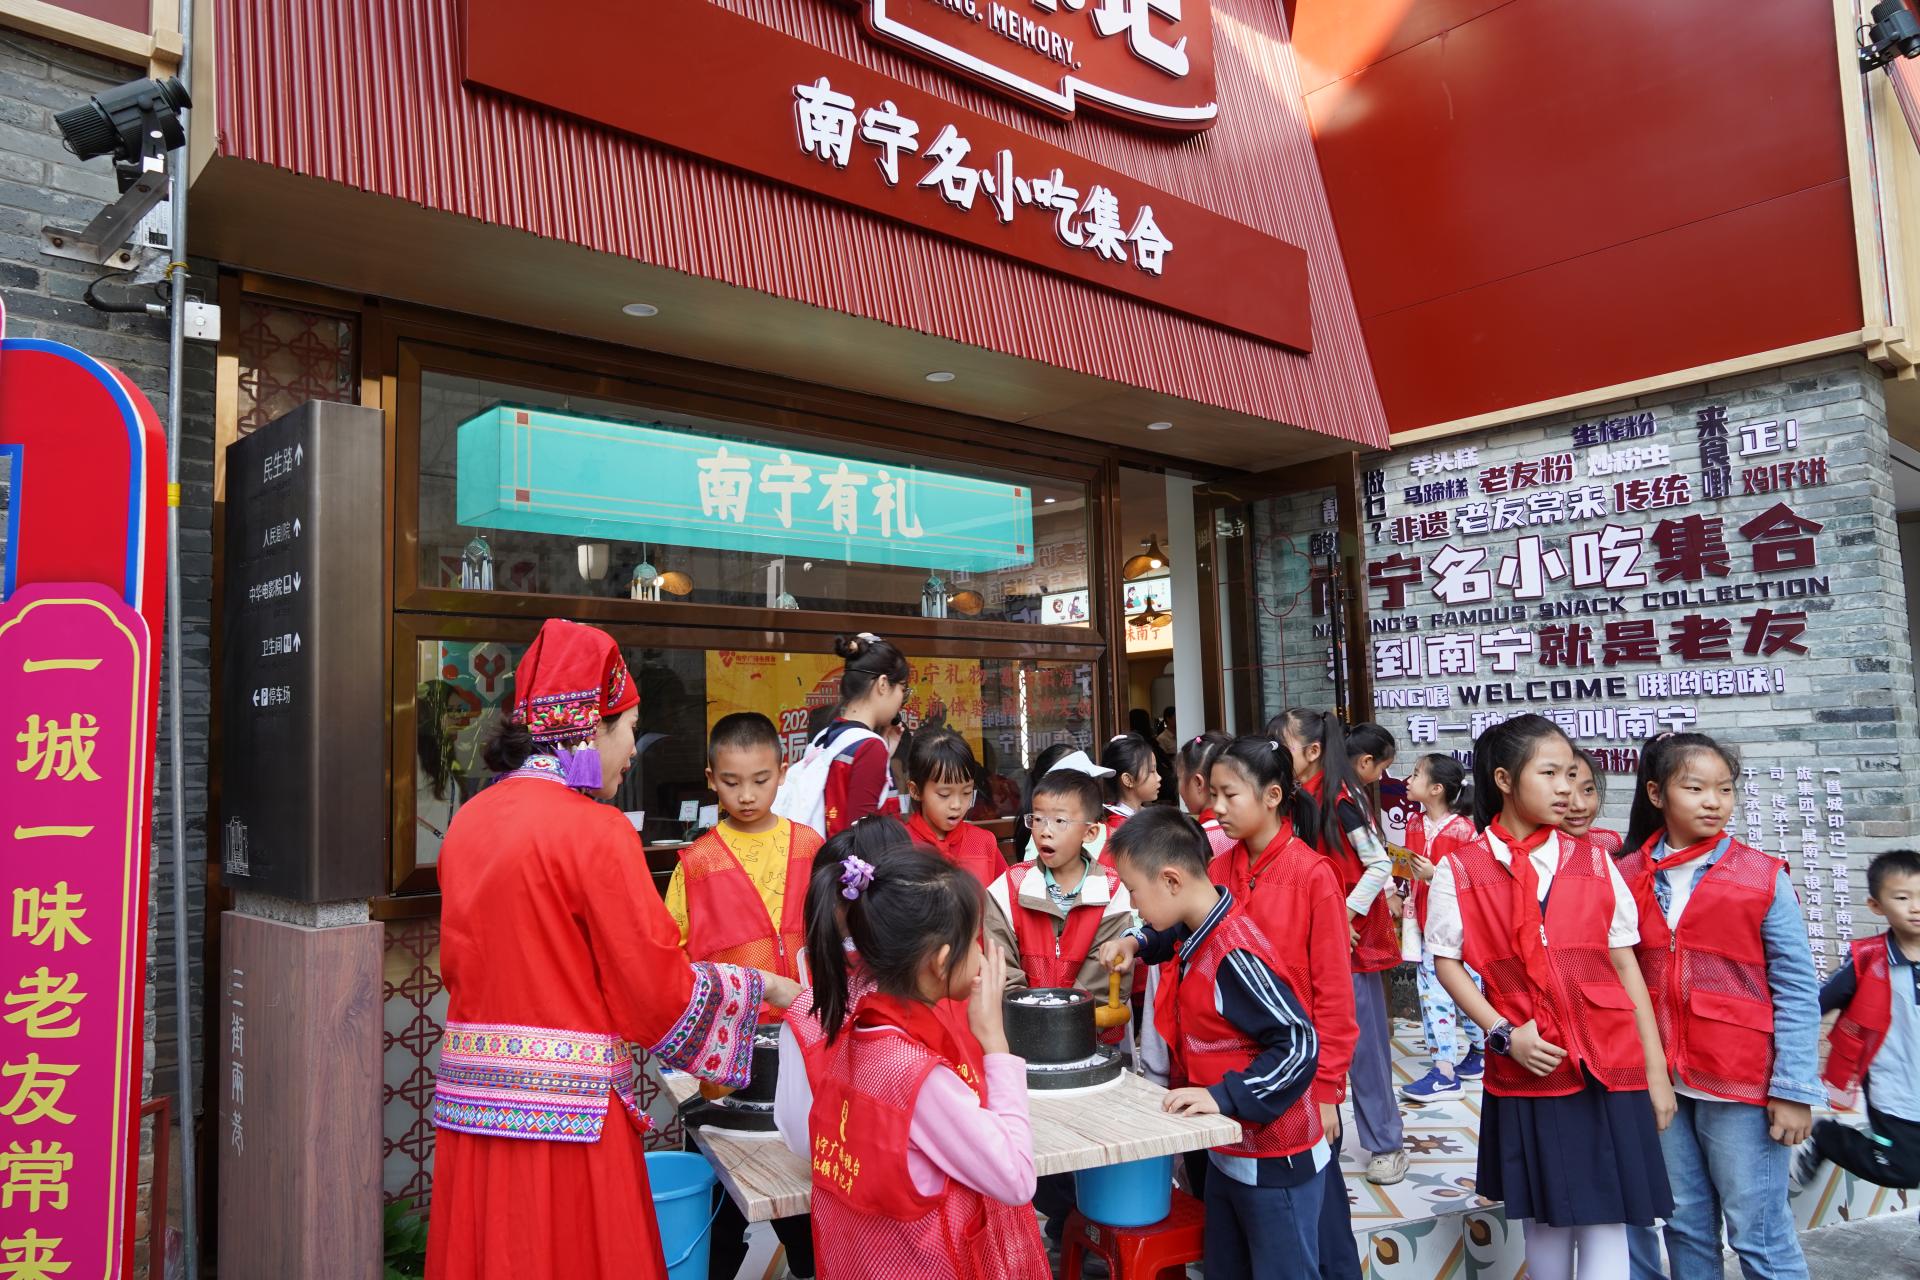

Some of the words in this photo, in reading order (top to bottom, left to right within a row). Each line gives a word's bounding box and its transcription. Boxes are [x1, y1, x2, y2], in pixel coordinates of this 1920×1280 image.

[990, 2, 1083, 70] MEMORY.
[795, 76, 1174, 276] 南宁名小吃集合
[1571, 412, 1657, 447] 生榨粉
[264, 446, 293, 483] 民生路
[1410, 447, 1480, 477] 芋头糕
[1478, 452, 1575, 495] 老友粉
[1587, 444, 1670, 476] 炒粉虫
[1742, 456, 1828, 495] 鸡仔饼
[696, 446, 924, 538] 南宁有礼
[1404, 476, 1470, 506] 马蹄糕
[1456, 485, 1608, 534] 老友常来
[1613, 473, 1692, 513] 传统
[1391, 510, 1451, 545] 非遗
[249, 577, 283, 603] 中华电影院
[1431, 604, 1527, 628] FAMOUS
[1539, 595, 1629, 618] SNACK
[1642, 576, 1830, 610] COLLECTION
[261, 636, 283, 657] 卫生间
[269, 685, 291, 706] 停车场
[1457, 676, 1627, 706] WELCOME
[782, 709, 810, 733] 202
[1407, 705, 1697, 744] 有一种福叫南宁
[0, 658, 103, 1280] 一城一味老友常来
